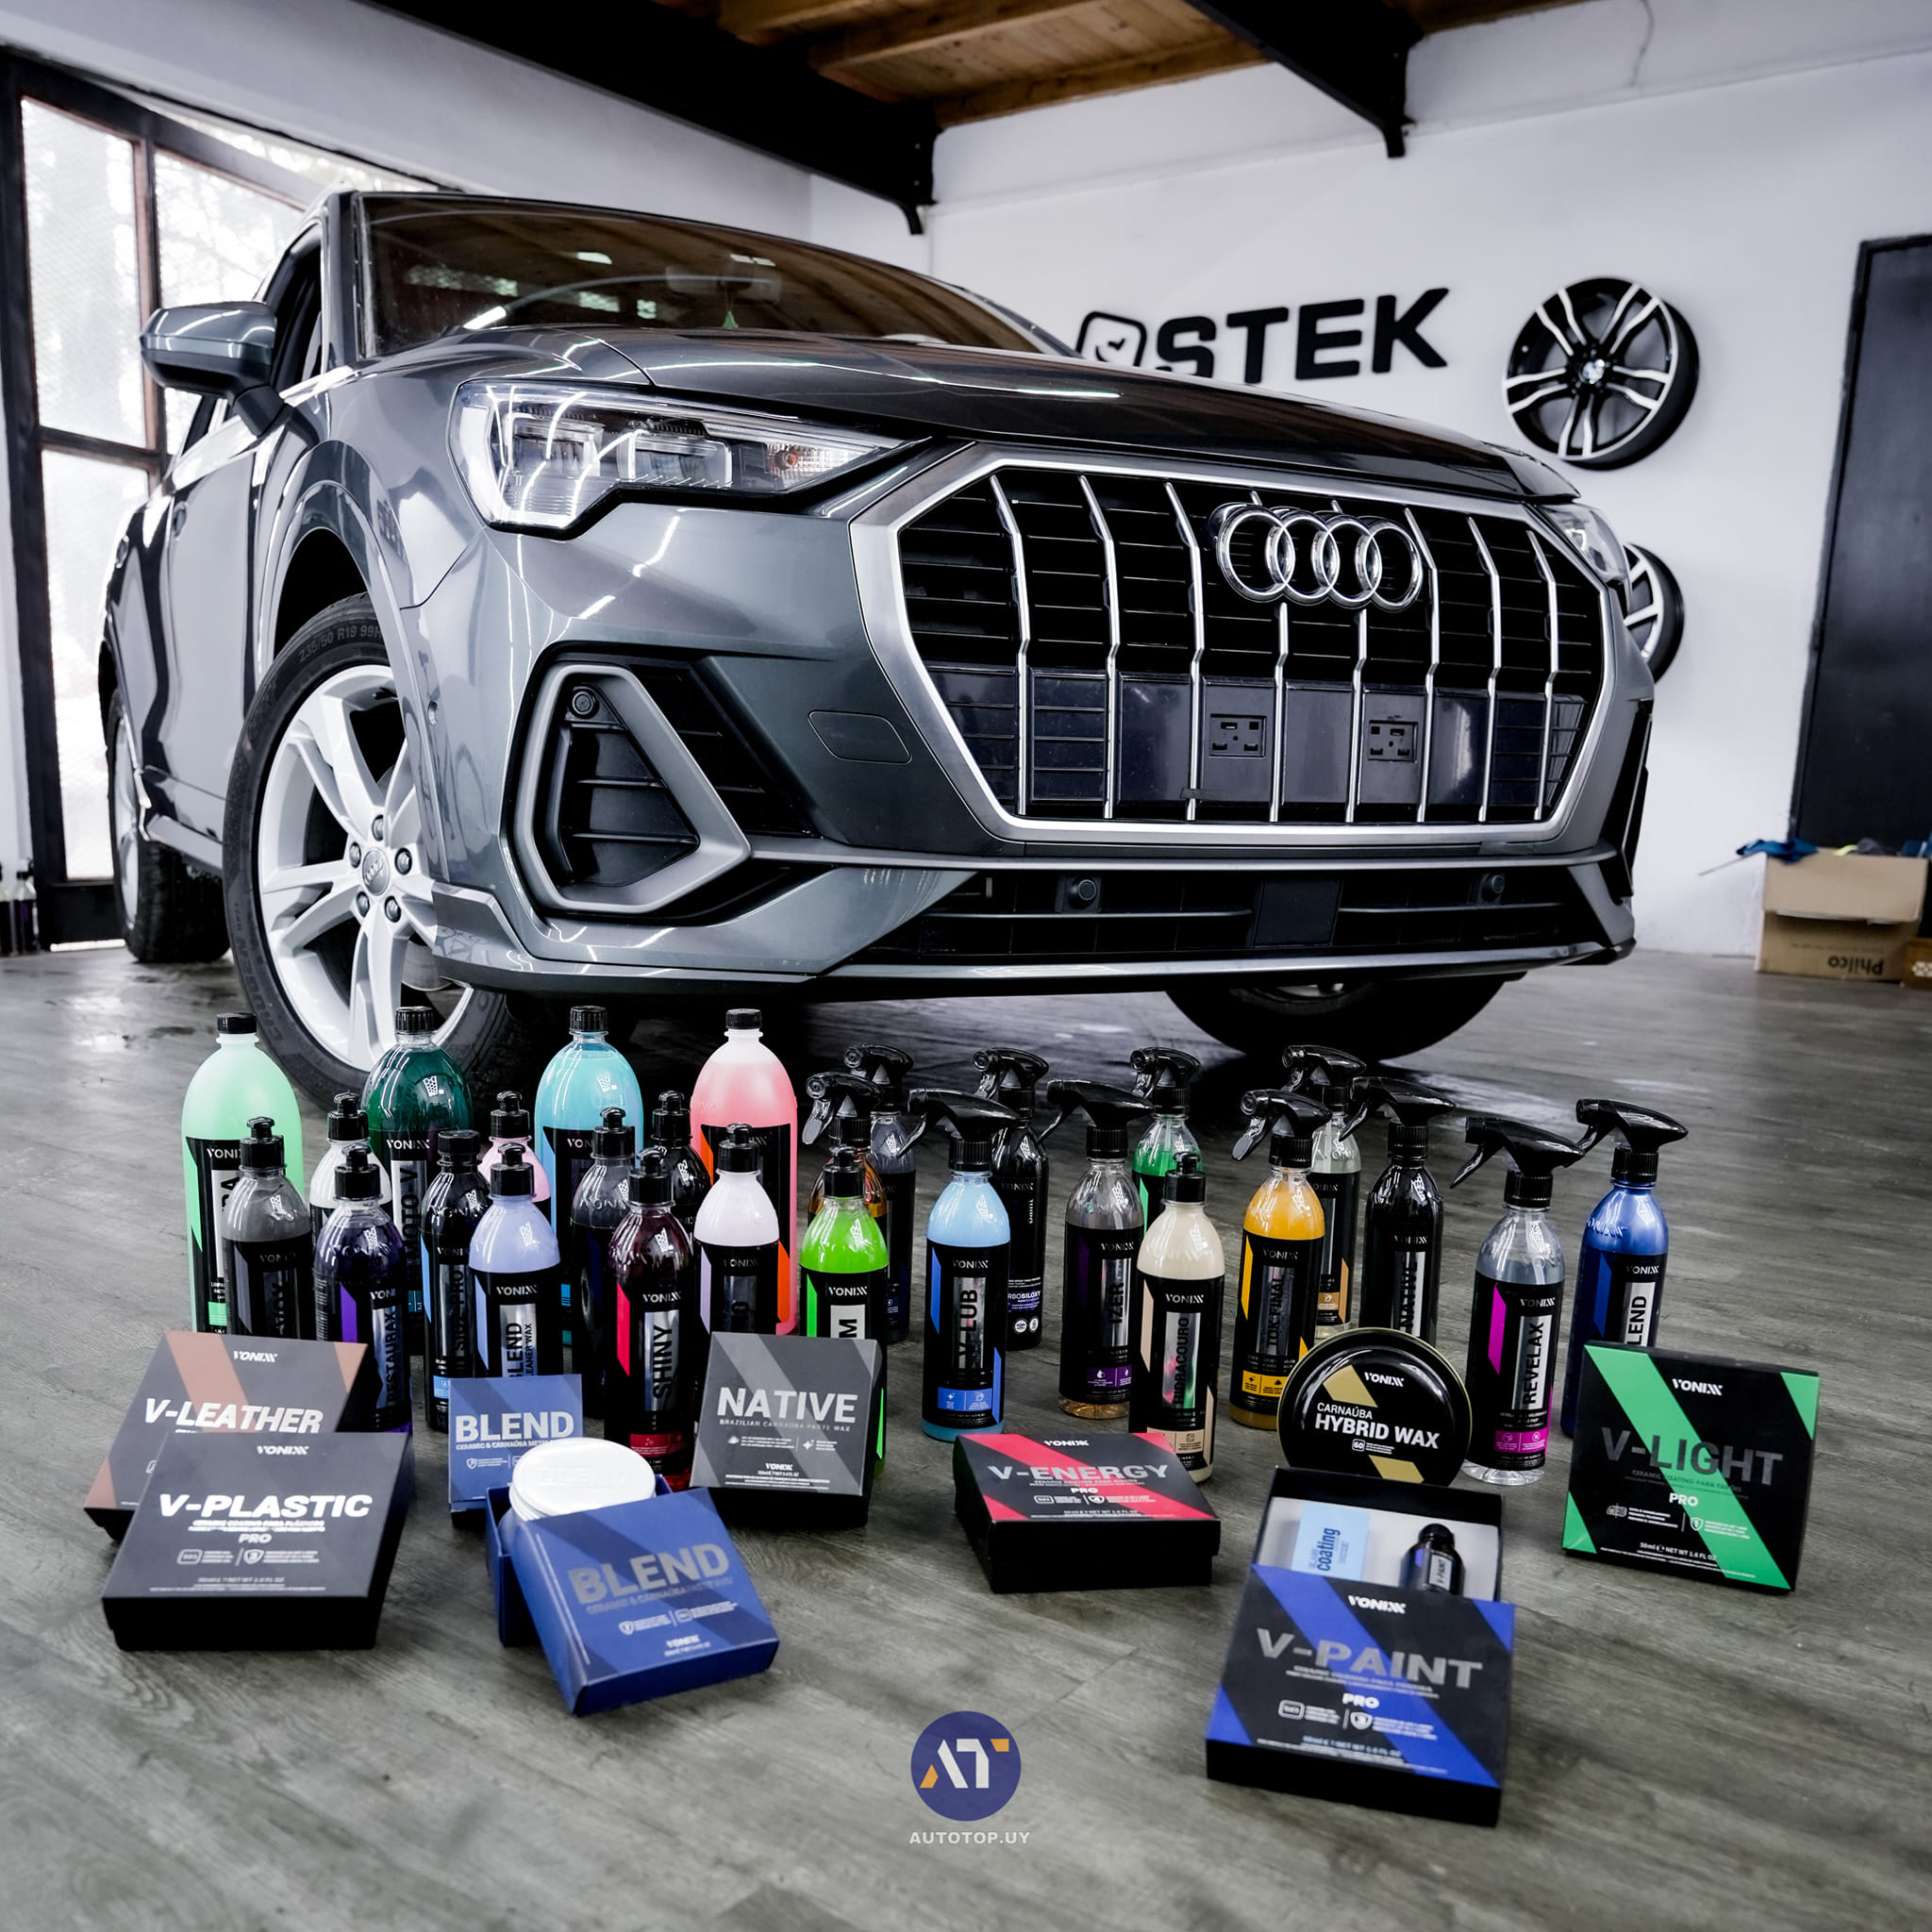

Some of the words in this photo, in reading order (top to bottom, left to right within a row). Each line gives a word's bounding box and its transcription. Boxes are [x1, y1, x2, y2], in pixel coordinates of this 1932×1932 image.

[1157, 287, 1450, 384] STEK
[299, 632, 334, 664] 235/50
[337, 625, 358, 641] R19
[1827, 954, 1886, 976] Philco
[207, 1147, 241, 1159] VONI
[1311, 1183, 1339, 1192] ONIXX
[437, 1246, 471, 1257] VONI
[370, 1288, 396, 1301] VONI
[496, 1284, 539, 1296] VONIXX
[642, 1291, 682, 1303] VONIXX
[828, 1286, 868, 1296] VONIXX
[1165, 1293, 1205, 1305] VONIXX
[1626, 1295, 1647, 1346] LEND
[233, 1350, 278, 1363] VONIXX
[383, 1309, 398, 1405] RESTAURAX
[525, 1344, 534, 1376] EANER
[652, 1324, 673, 1400] SHINY
[1174, 1316, 1191, 1406] HIDRACOURO
[1522, 1322, 1545, 1406] REVELAX
[1364, 1371, 1405, 1388] VONIXX
[1672, 1377, 1724, 1397] VONIXX
[717, 1387, 858, 1424] NATIVE
[1317, 1402, 1373, 1420] CARNAÚBA
[144, 1397, 325, 1435] V-LEATHER
[719, 1419, 760, 1427] BRAZILIAN
[455, 1410, 575, 1443] BLEND
[1315, 1413, 1390, 1441] HYBRID
[1394, 1425, 1441, 1449] WAX
[257, 1445, 309, 1456] VONIXX
[1601, 1426, 1784, 1486] V-LIGHT
[988, 1464, 1169, 1480] V-ENERGY
[159, 1493, 374, 1519] V-PLASTIC
[1669, 1492, 1699, 1507] PRO
[238, 1533, 273, 1544] PRO
[1316, 1526, 1341, 1572] coating
[567, 1542, 730, 1606] BLEND
[1348, 1594, 1407, 1614] VONIXX
[1257, 1627, 1483, 1690] V-PAINT
[1342, 1692, 1380, 1709] PRO
